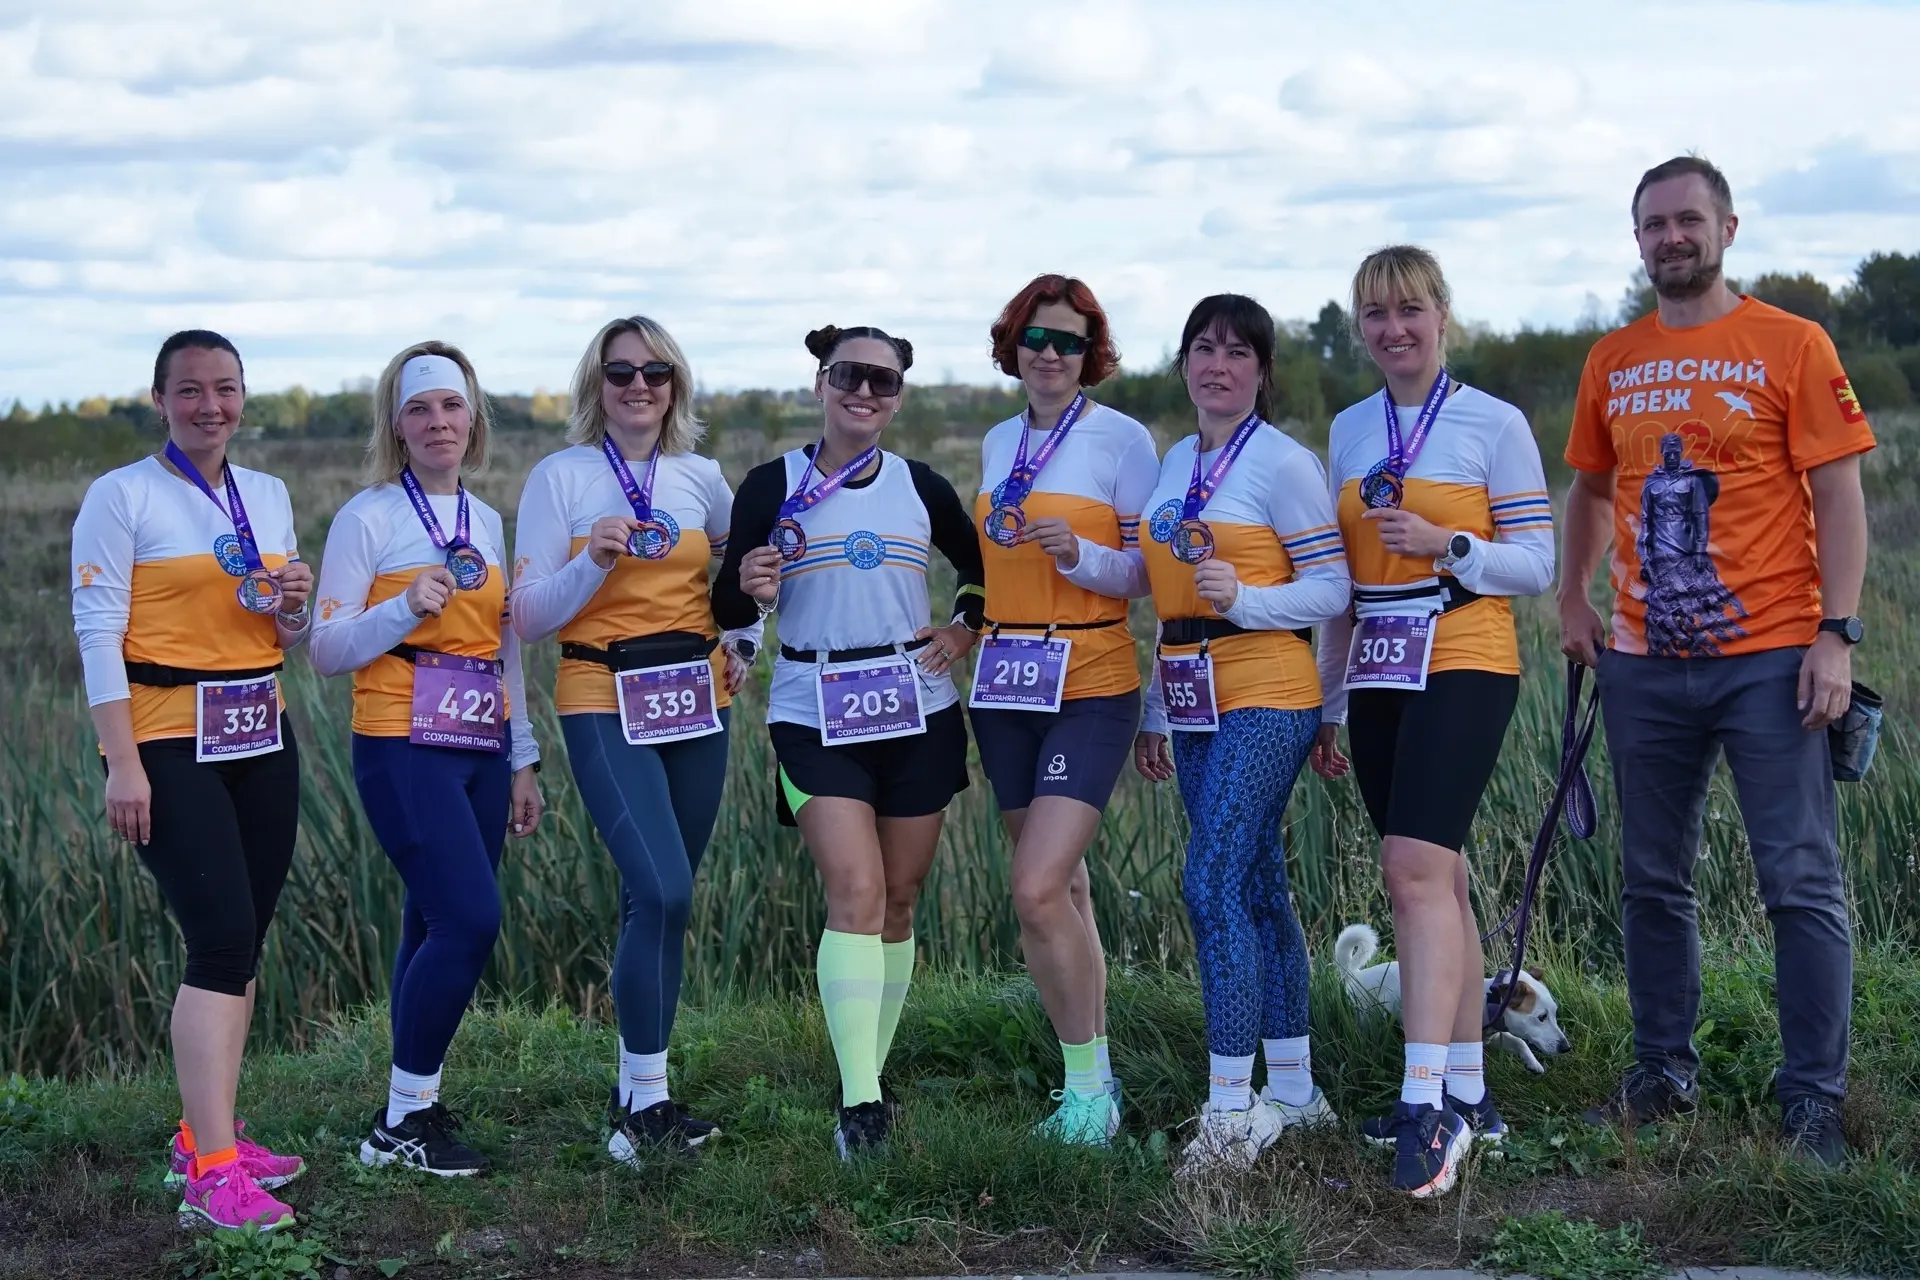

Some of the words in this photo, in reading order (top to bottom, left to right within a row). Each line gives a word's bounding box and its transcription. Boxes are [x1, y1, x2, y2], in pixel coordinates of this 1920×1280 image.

[1608, 358, 1766, 392] РЖЕВСКИЙ
[1607, 388, 1692, 417] РУБЕЖ
[1407, 412, 1430, 454] РЖЕВСКИЙ
[1426, 387, 1442, 413] РУБЕЖ
[1036, 429, 1061, 461] РЖЕВСКИЙ
[1057, 408, 1075, 431] РУБЕЖ
[1213, 443, 1237, 478] РЖЕВСКИЙ
[1234, 424, 1250, 445] РУБЕЖ
[403, 471, 414, 488] 2026
[822, 468, 850, 491] РЖЕВСКИЙ
[848, 456, 868, 472] РУБЕЖ
[411, 487, 427, 512] РУБЕЖ
[422, 511, 445, 546] ЖЕВСКИЙ
[846, 531, 885, 552] СОЛНЕЧНОГОРСК
[855, 560, 878, 568] БЕЖИТ
[1359, 637, 1407, 664] 303
[993, 660, 1039, 686] 219
[1380, 673, 1411, 682] ПАМЯТЬ
[437, 687, 496, 724] 422
[644, 689, 696, 720] 339
[842, 688, 900, 719] 203
[981, 694, 1016, 702] СОХРАНЯЯ
[1016, 695, 1046, 704] ПАМЯТЬ
[1166, 682, 1197, 708] 355
[223, 704, 267, 735] 332
[638, 727, 679, 738] СОХРАНЯЯ
[680, 722, 707, 732] ПАМЯТЬ
[836, 726, 880, 737] СОХРАНЯЯ
[880, 722, 911, 732] ПАМЯТЬ
[211, 743, 251, 754] СОХРАНЯЯ
[251, 738, 272, 749] ПАМЯТЬ
[423, 731, 472, 744] СОХРАНЯЯ
[473, 737, 500, 748] ПАМЯТЬ
